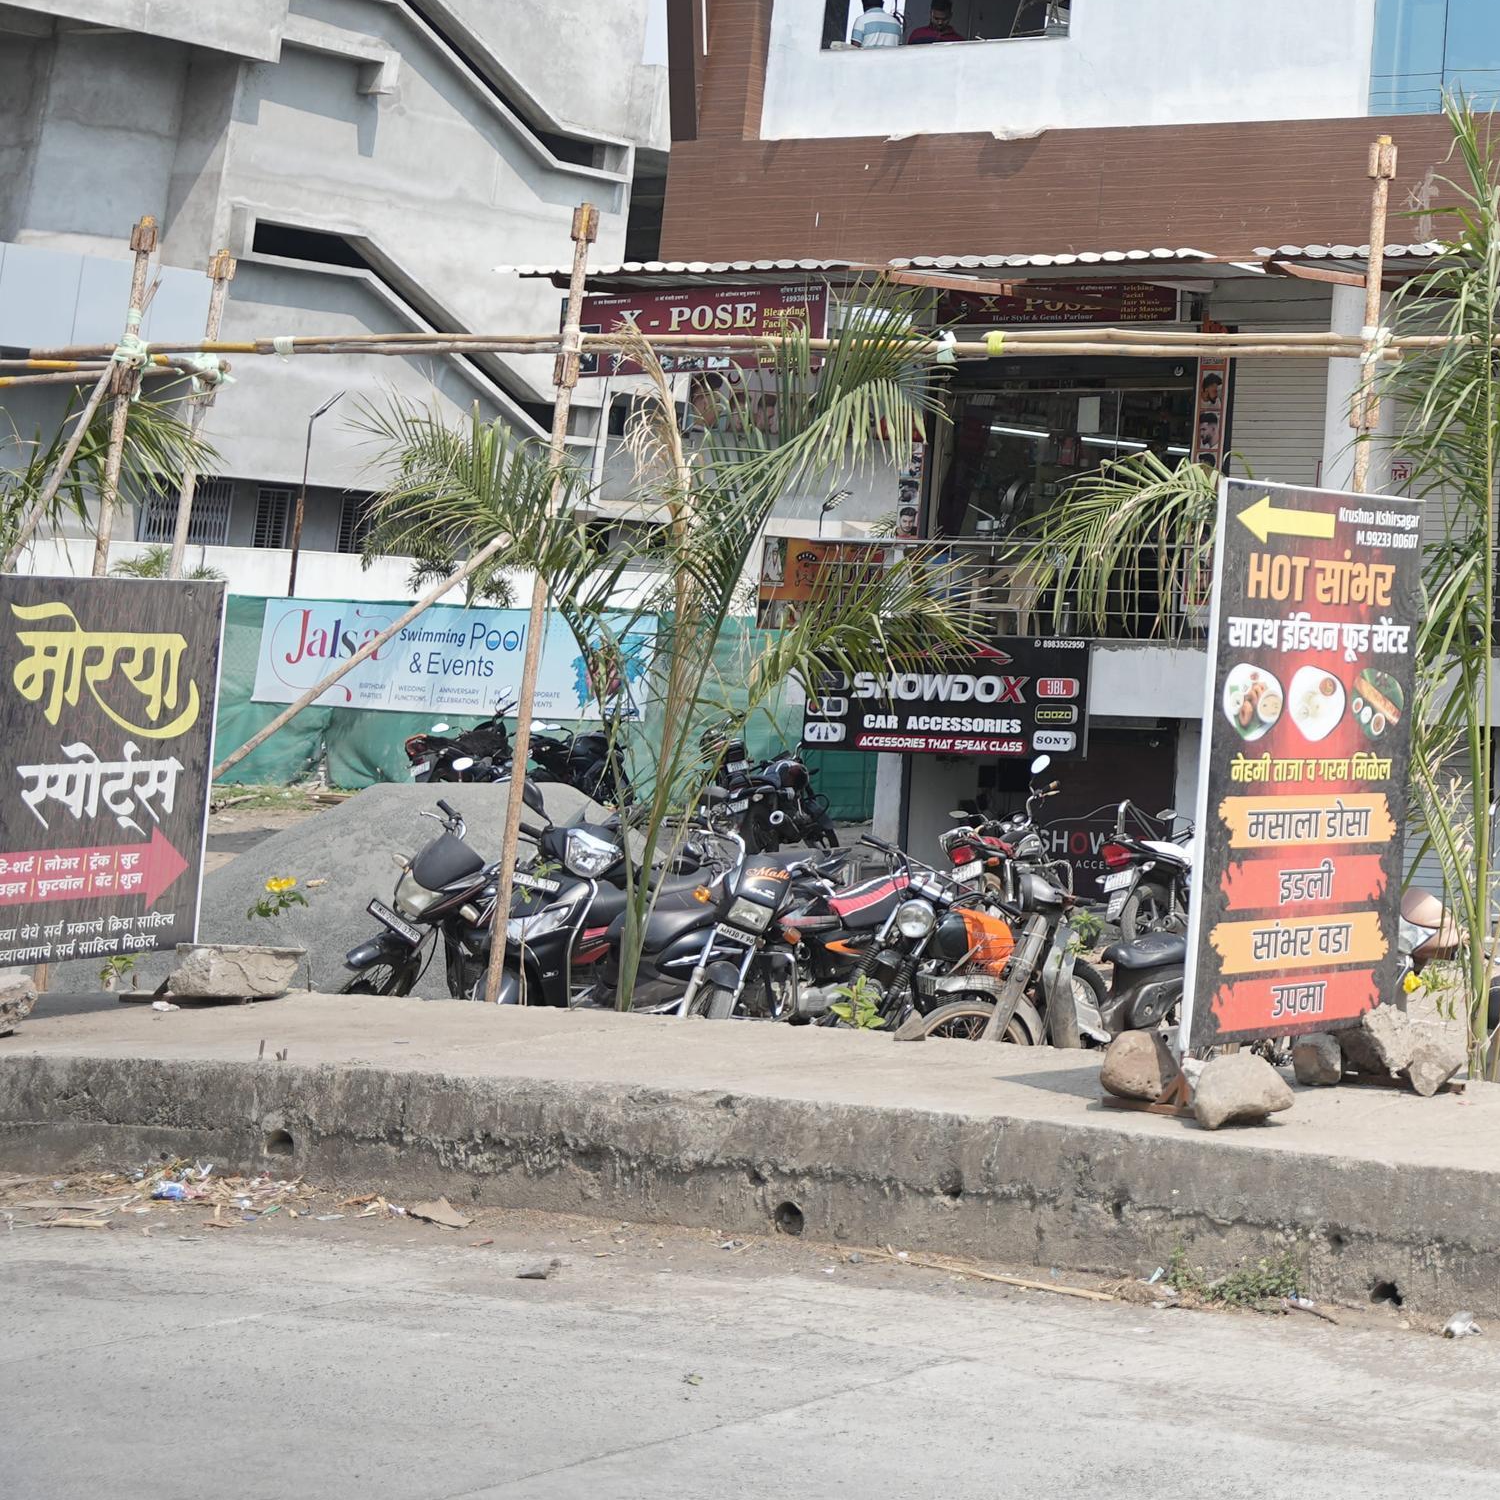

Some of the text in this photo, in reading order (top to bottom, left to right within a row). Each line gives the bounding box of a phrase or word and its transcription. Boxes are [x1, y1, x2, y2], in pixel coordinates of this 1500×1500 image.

[669, 303, 757, 332] POSE
[993, 314, 1009, 322] Hair
[1011, 314, 1030, 322] Style
[1339, 506, 1420, 530] Krushna Kshirsagar
[1356, 530, 1419, 549] M.99233 00607
[1248, 549, 1396, 606] HOT सांभर
[285, 608, 526, 665] Jalsa Swimming Pool
[1043, 639, 1085, 650] 8983552950
[1227, 611, 1410, 662] साउथ इंडियन फूड सेंटर
[10, 601, 200, 739] मोरया
[409, 651, 495, 677] & Events
[359, 682, 480, 695] BIRTHDAY WEDDING ANNIVERSARY
[436, 695, 479, 705] CELEBRATIONS
[851, 671, 1030, 704] SHOWDOX
[1047, 679, 1066, 695] JBL
[863, 713, 1022, 734] CAR ACCESSORIES
[859, 736, 1023, 752] ACCESSORIES THAT SPEAK CLASS
[1036, 734, 1070, 746] SONY
[1230, 752, 1393, 783] नेहमी ताजा व गरम मिळेल
[16, 740, 185, 836] स्पोर्ट्स
[1247, 804, 1372, 843] मसाला डोसा
[44, 854, 80, 872] लोअर
[121, 853, 140, 869] सुट
[38, 872, 143, 896] फुटबॉल बॅट शुज
[1278, 862, 1334, 904] इडली
[44, 919, 65, 938] सर्व
[67, 917, 105, 935] प्रकारचे
[108, 915, 134, 932] क्रिडा
[137, 911, 175, 928] साहित्य
[56, 933, 159, 957] सर्व साहित्य मिळेल.
[1253, 921, 1351, 960] सांभर वडा
[1270, 982, 1326, 1017] उपमा
